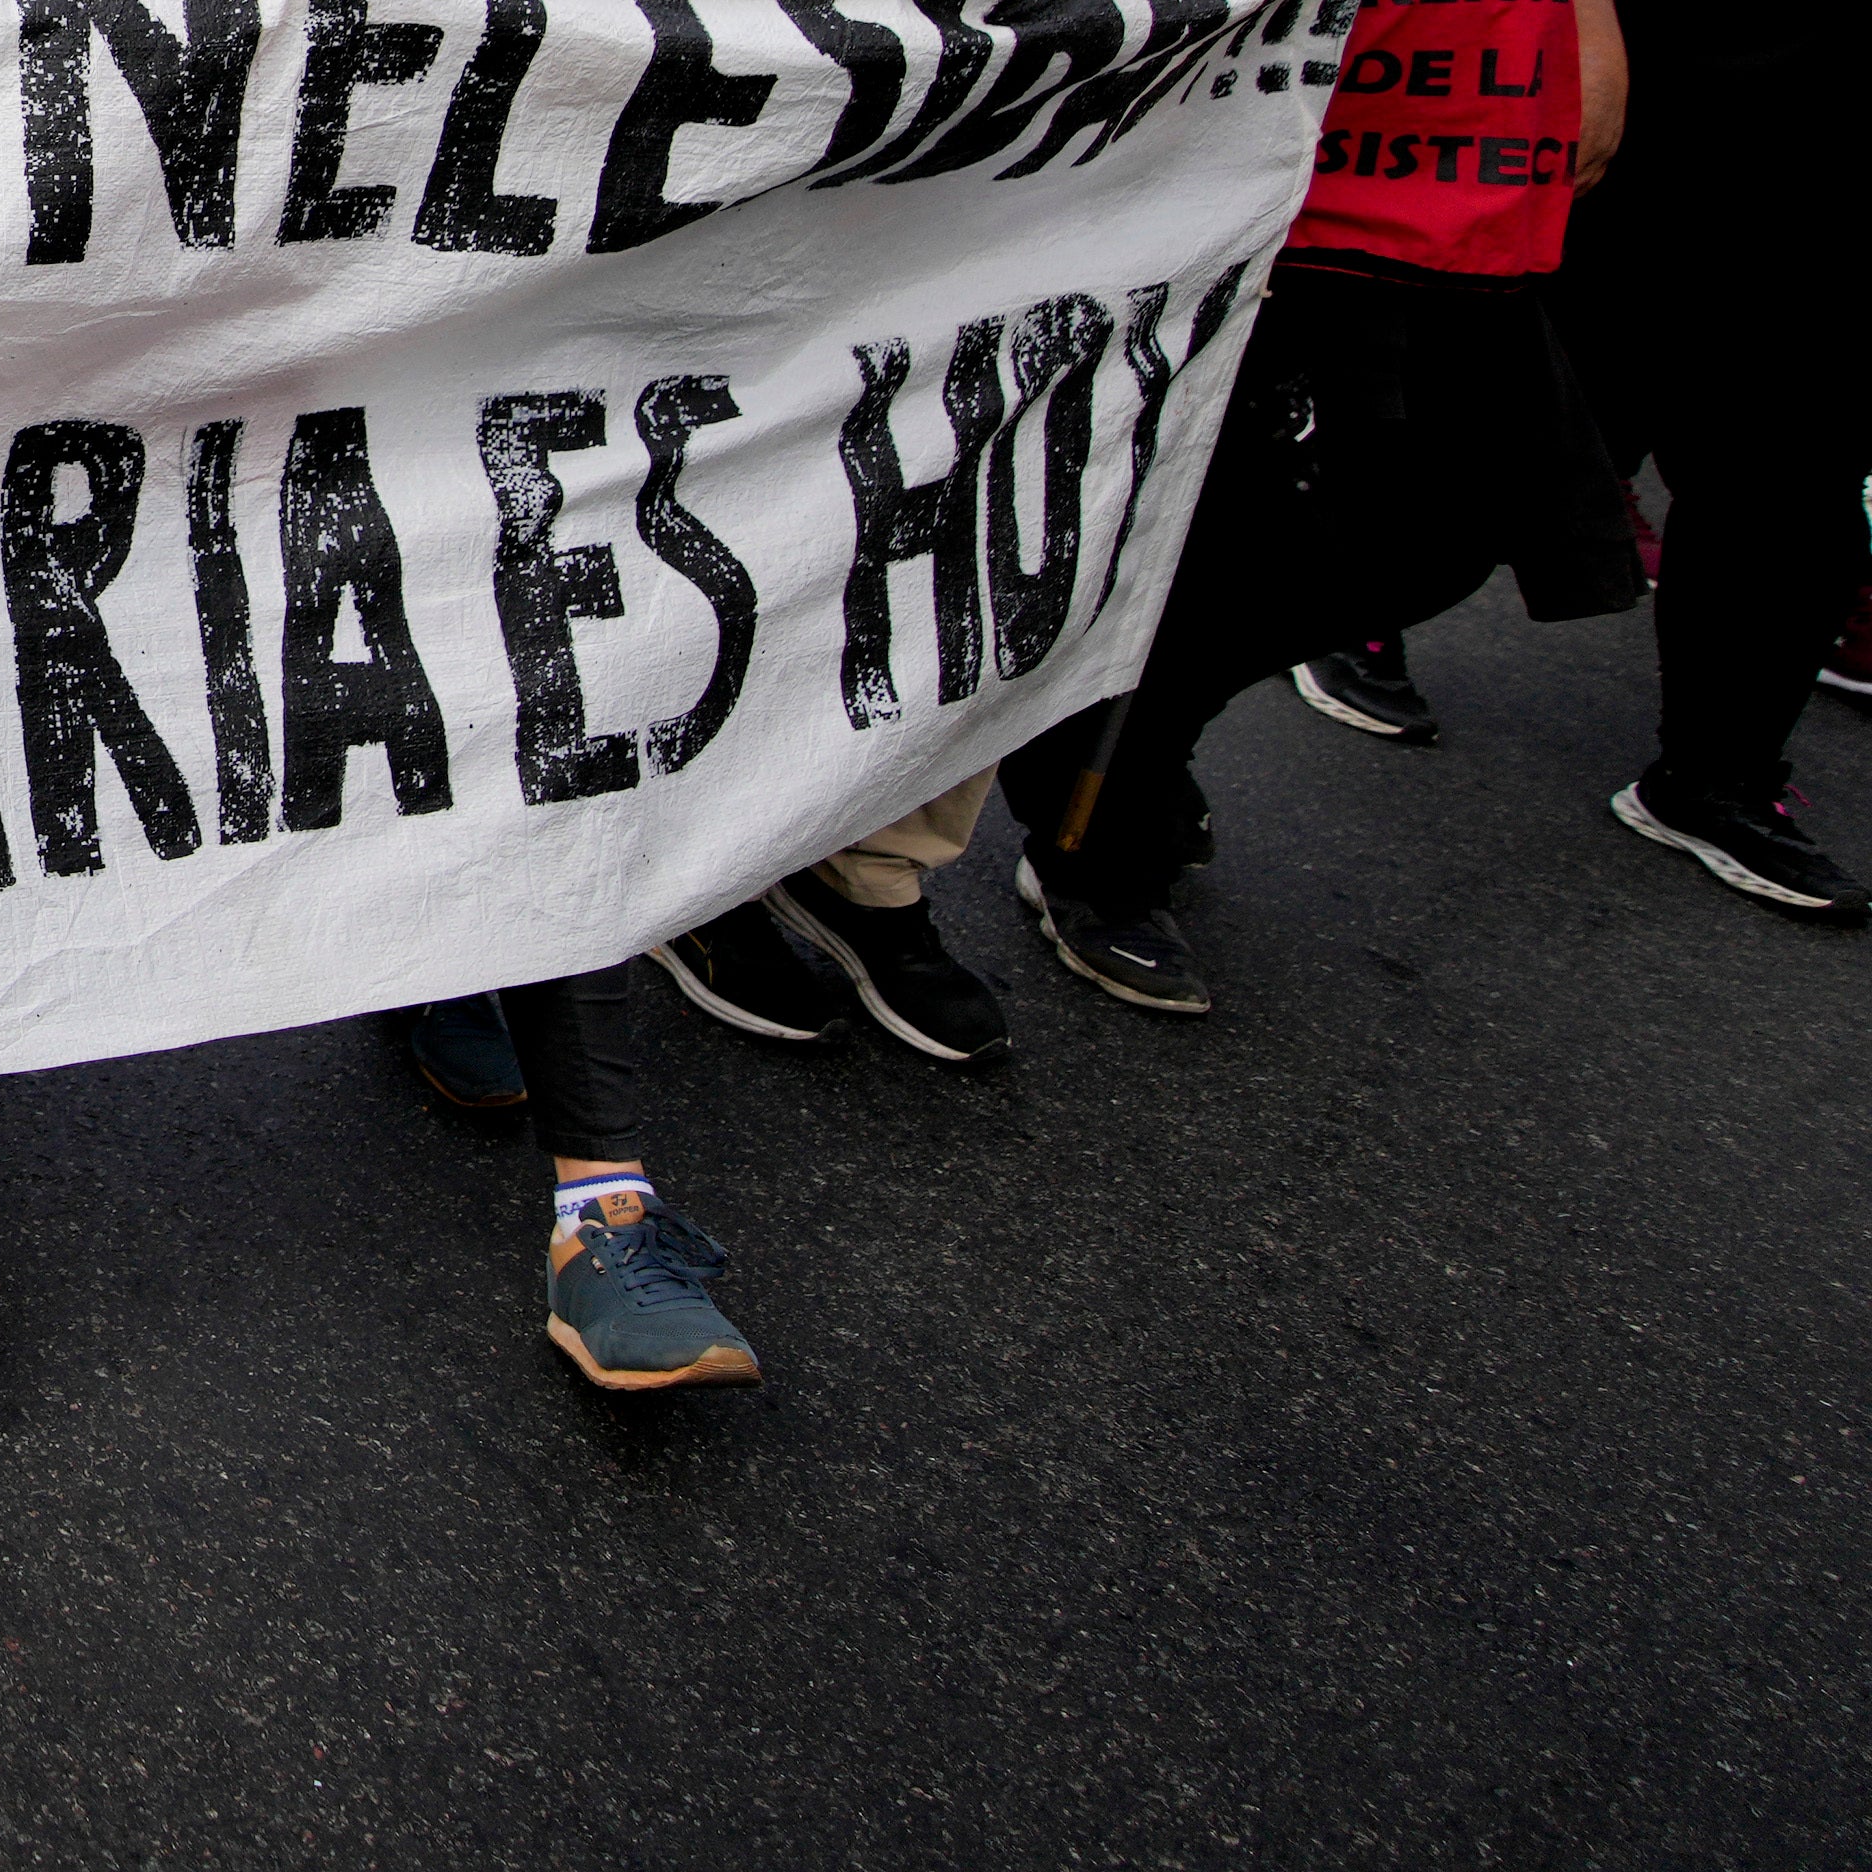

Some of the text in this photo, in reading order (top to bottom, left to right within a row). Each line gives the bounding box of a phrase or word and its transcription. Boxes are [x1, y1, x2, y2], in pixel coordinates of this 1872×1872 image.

[1338, 48, 1455, 98] DE
[476, 374, 759, 808] ES
[838, 258, 1249, 730] HOY
[608, 1205, 640, 1219] TOPPER
